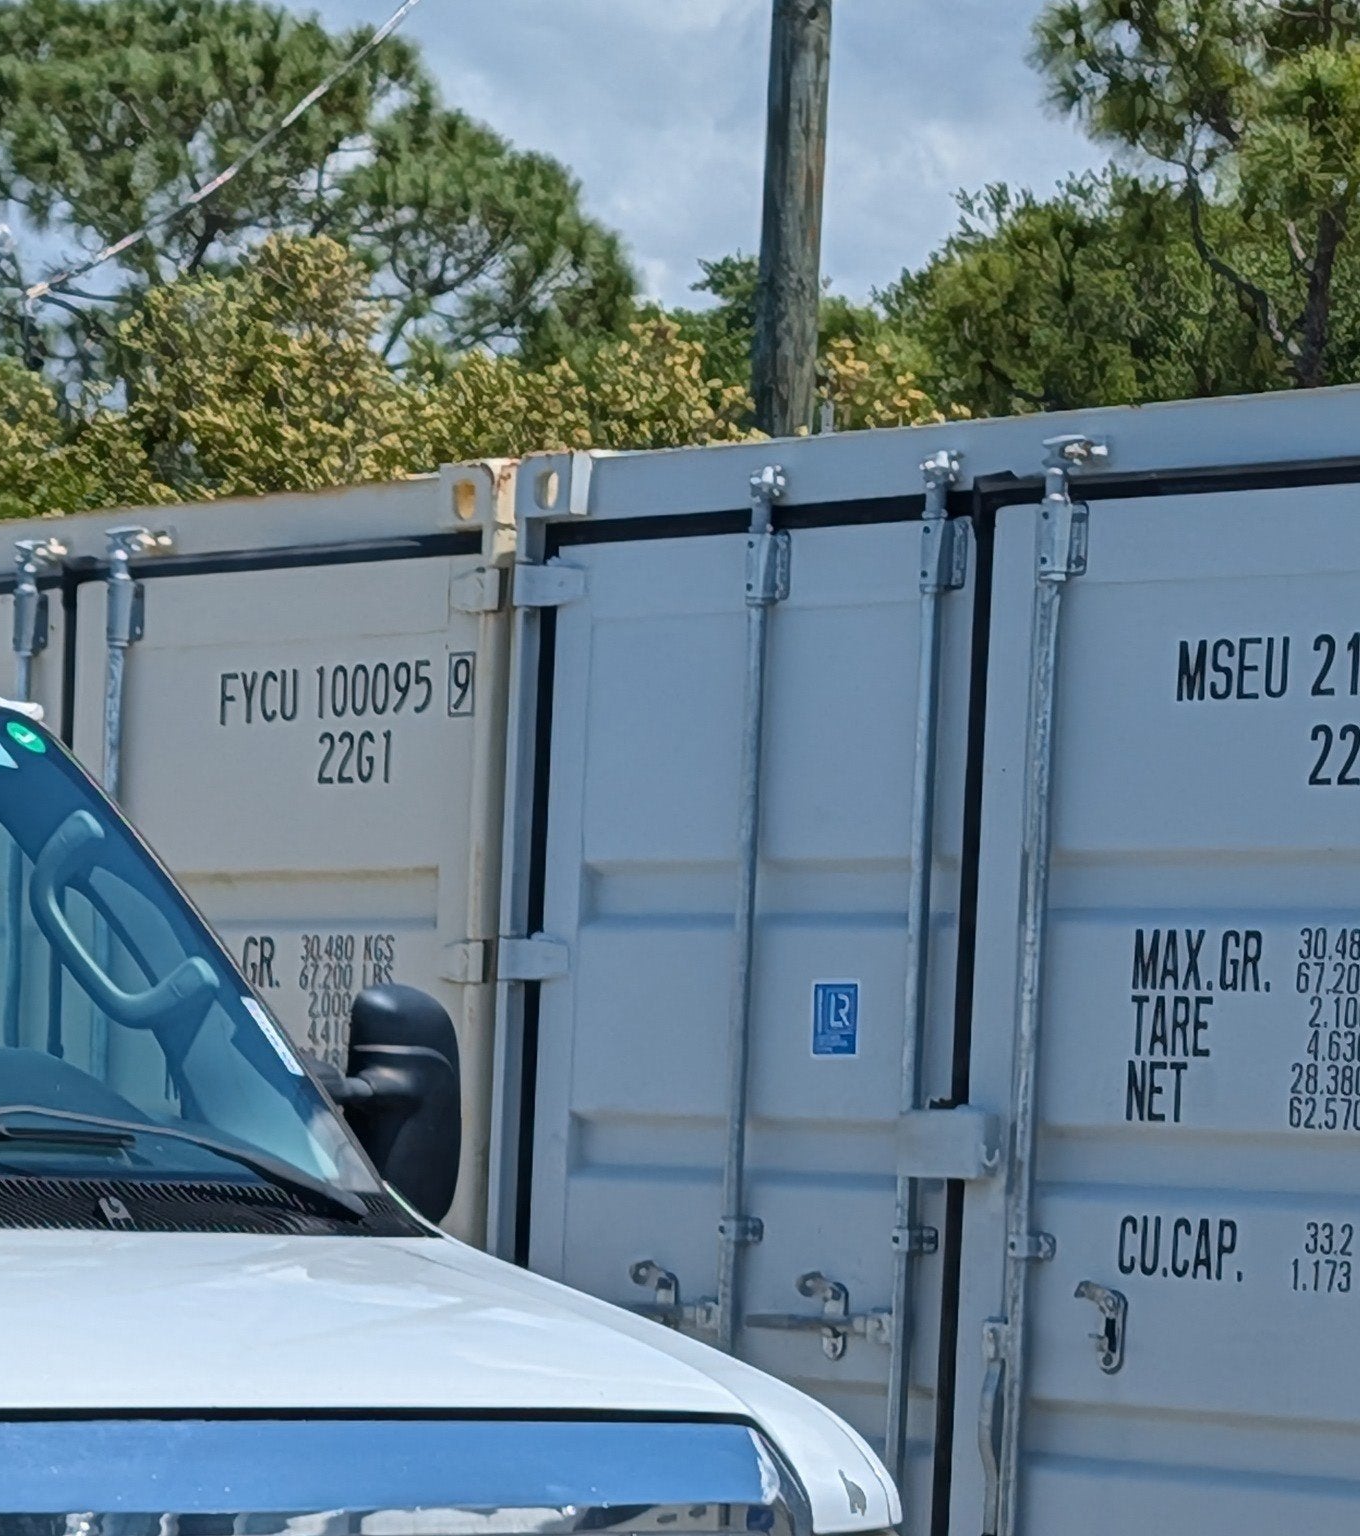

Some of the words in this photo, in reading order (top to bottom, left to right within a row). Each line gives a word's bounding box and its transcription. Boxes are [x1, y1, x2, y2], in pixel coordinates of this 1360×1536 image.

[219, 668, 298, 726] FYCU
[316, 659, 433, 719] 100095
[451, 656, 473, 713] 9
[1176, 636, 1290, 701] MSEU
[1311, 632, 1360, 696] 21
[317, 729, 392, 784] 22G1
[1308, 723, 1360, 786] 22
[242, 936, 281, 989] GR.
[363, 934, 395, 963] KGS
[1131, 995, 1214, 1058] TARE
[1308, 996, 1360, 1030] 2.10
[1307, 1029, 1360, 1063] 4.63
[1126, 1060, 1188, 1123] NET
[1305, 1221, 1354, 1257] 33.2
[1292, 1258, 1352, 1292] 1.173
